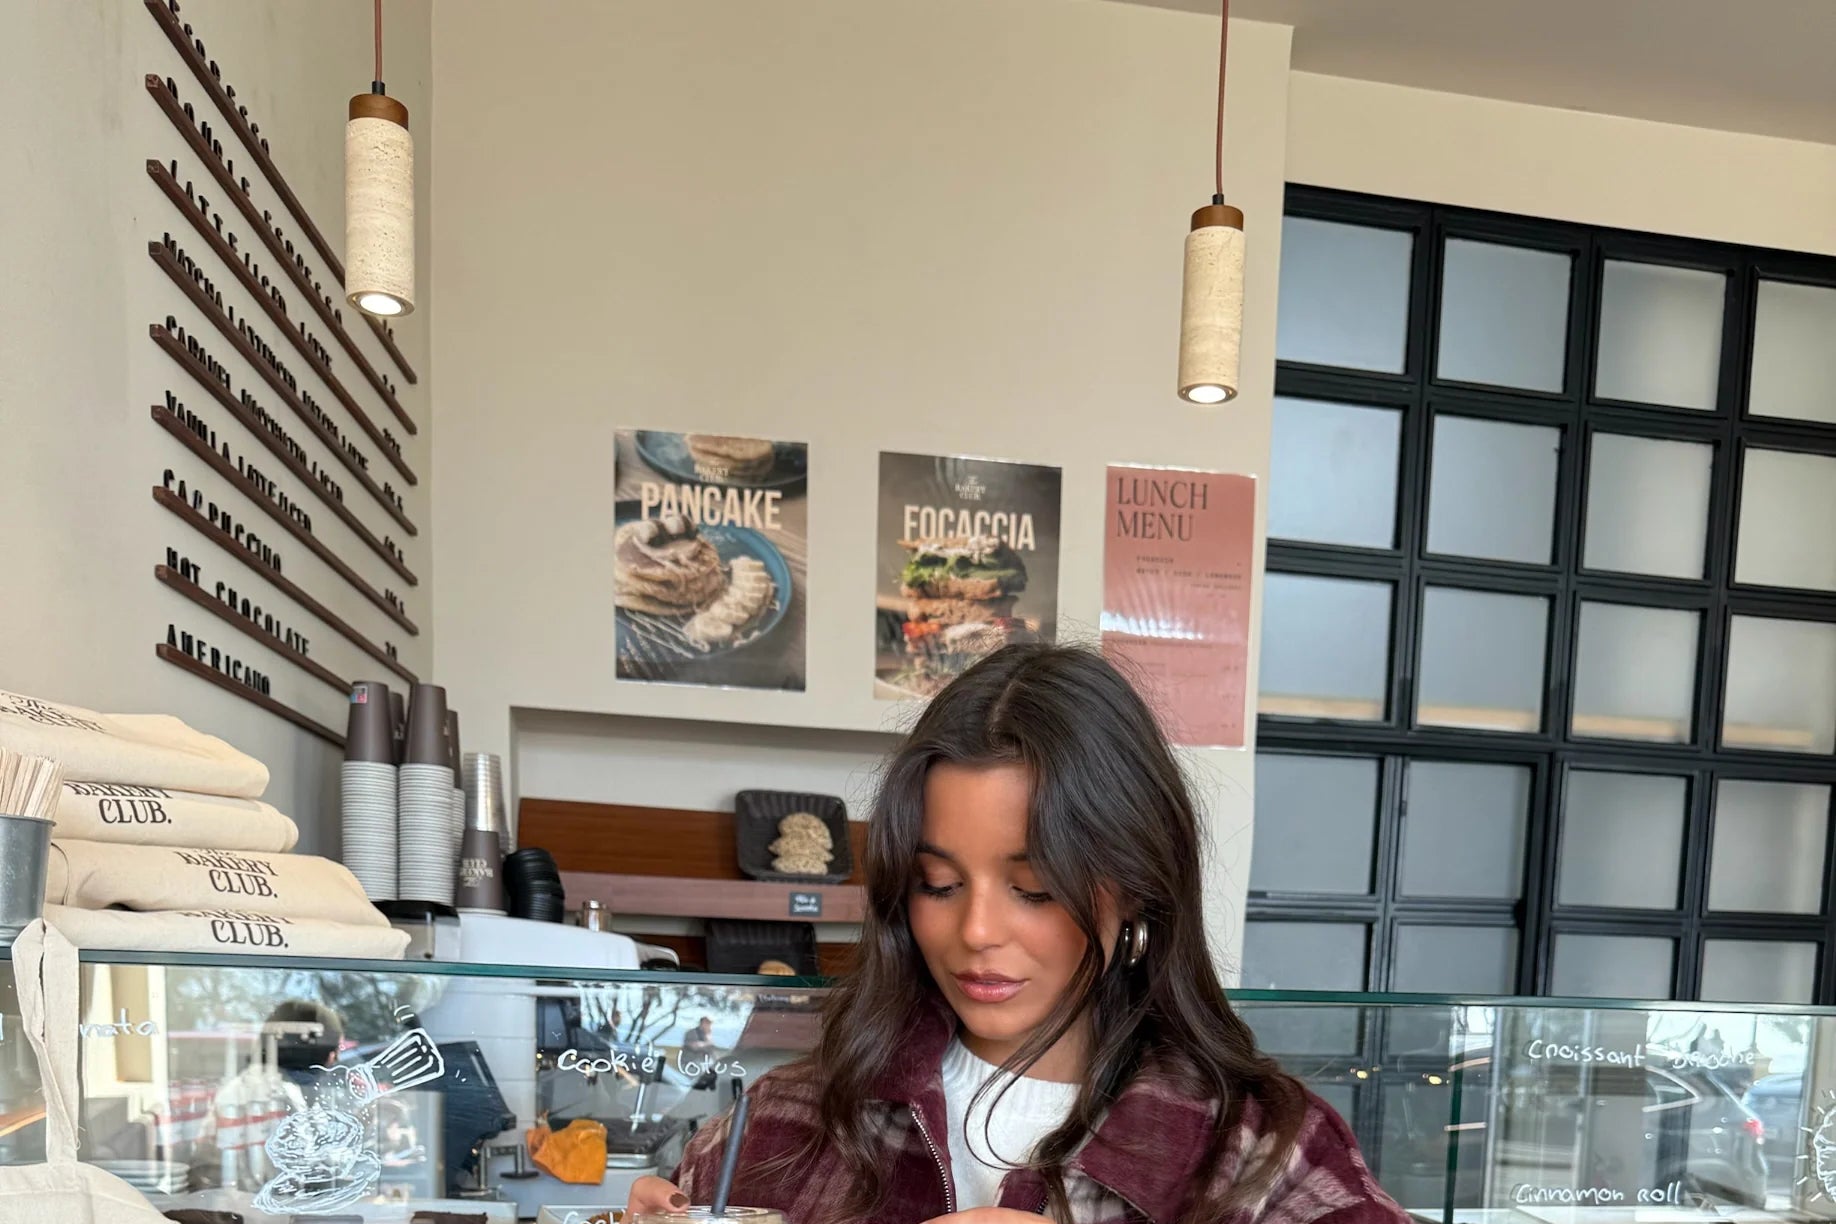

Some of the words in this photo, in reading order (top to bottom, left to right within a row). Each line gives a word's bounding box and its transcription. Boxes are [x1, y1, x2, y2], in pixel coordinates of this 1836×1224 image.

[166, 76, 251, 198] DOUBLE
[164, 232, 225, 312] MATCHA
[165, 390, 232, 465] VANILLA
[640, 483, 784, 530] PANCAKE
[1117, 477, 1209, 511] LUNCH
[162, 469, 282, 574] CAPPUCCINO
[903, 505, 1037, 552] FOCACCIA
[1116, 510, 1195, 542] MENU
[166, 546, 202, 587] HOT
[215, 581, 311, 656] CHOCOLATE
[166, 624, 271, 697] AMERICANO
[98, 798, 172, 824] CLUB.
[173, 851, 279, 877] BAKERY
[208, 869, 279, 899] CLUB.
[211, 919, 289, 948] CLUB.
[557, 1046, 656, 1073] Cookie
[1527, 1039, 1646, 1069] Croissant
[1515, 1183, 1625, 1205] Cinnamon
